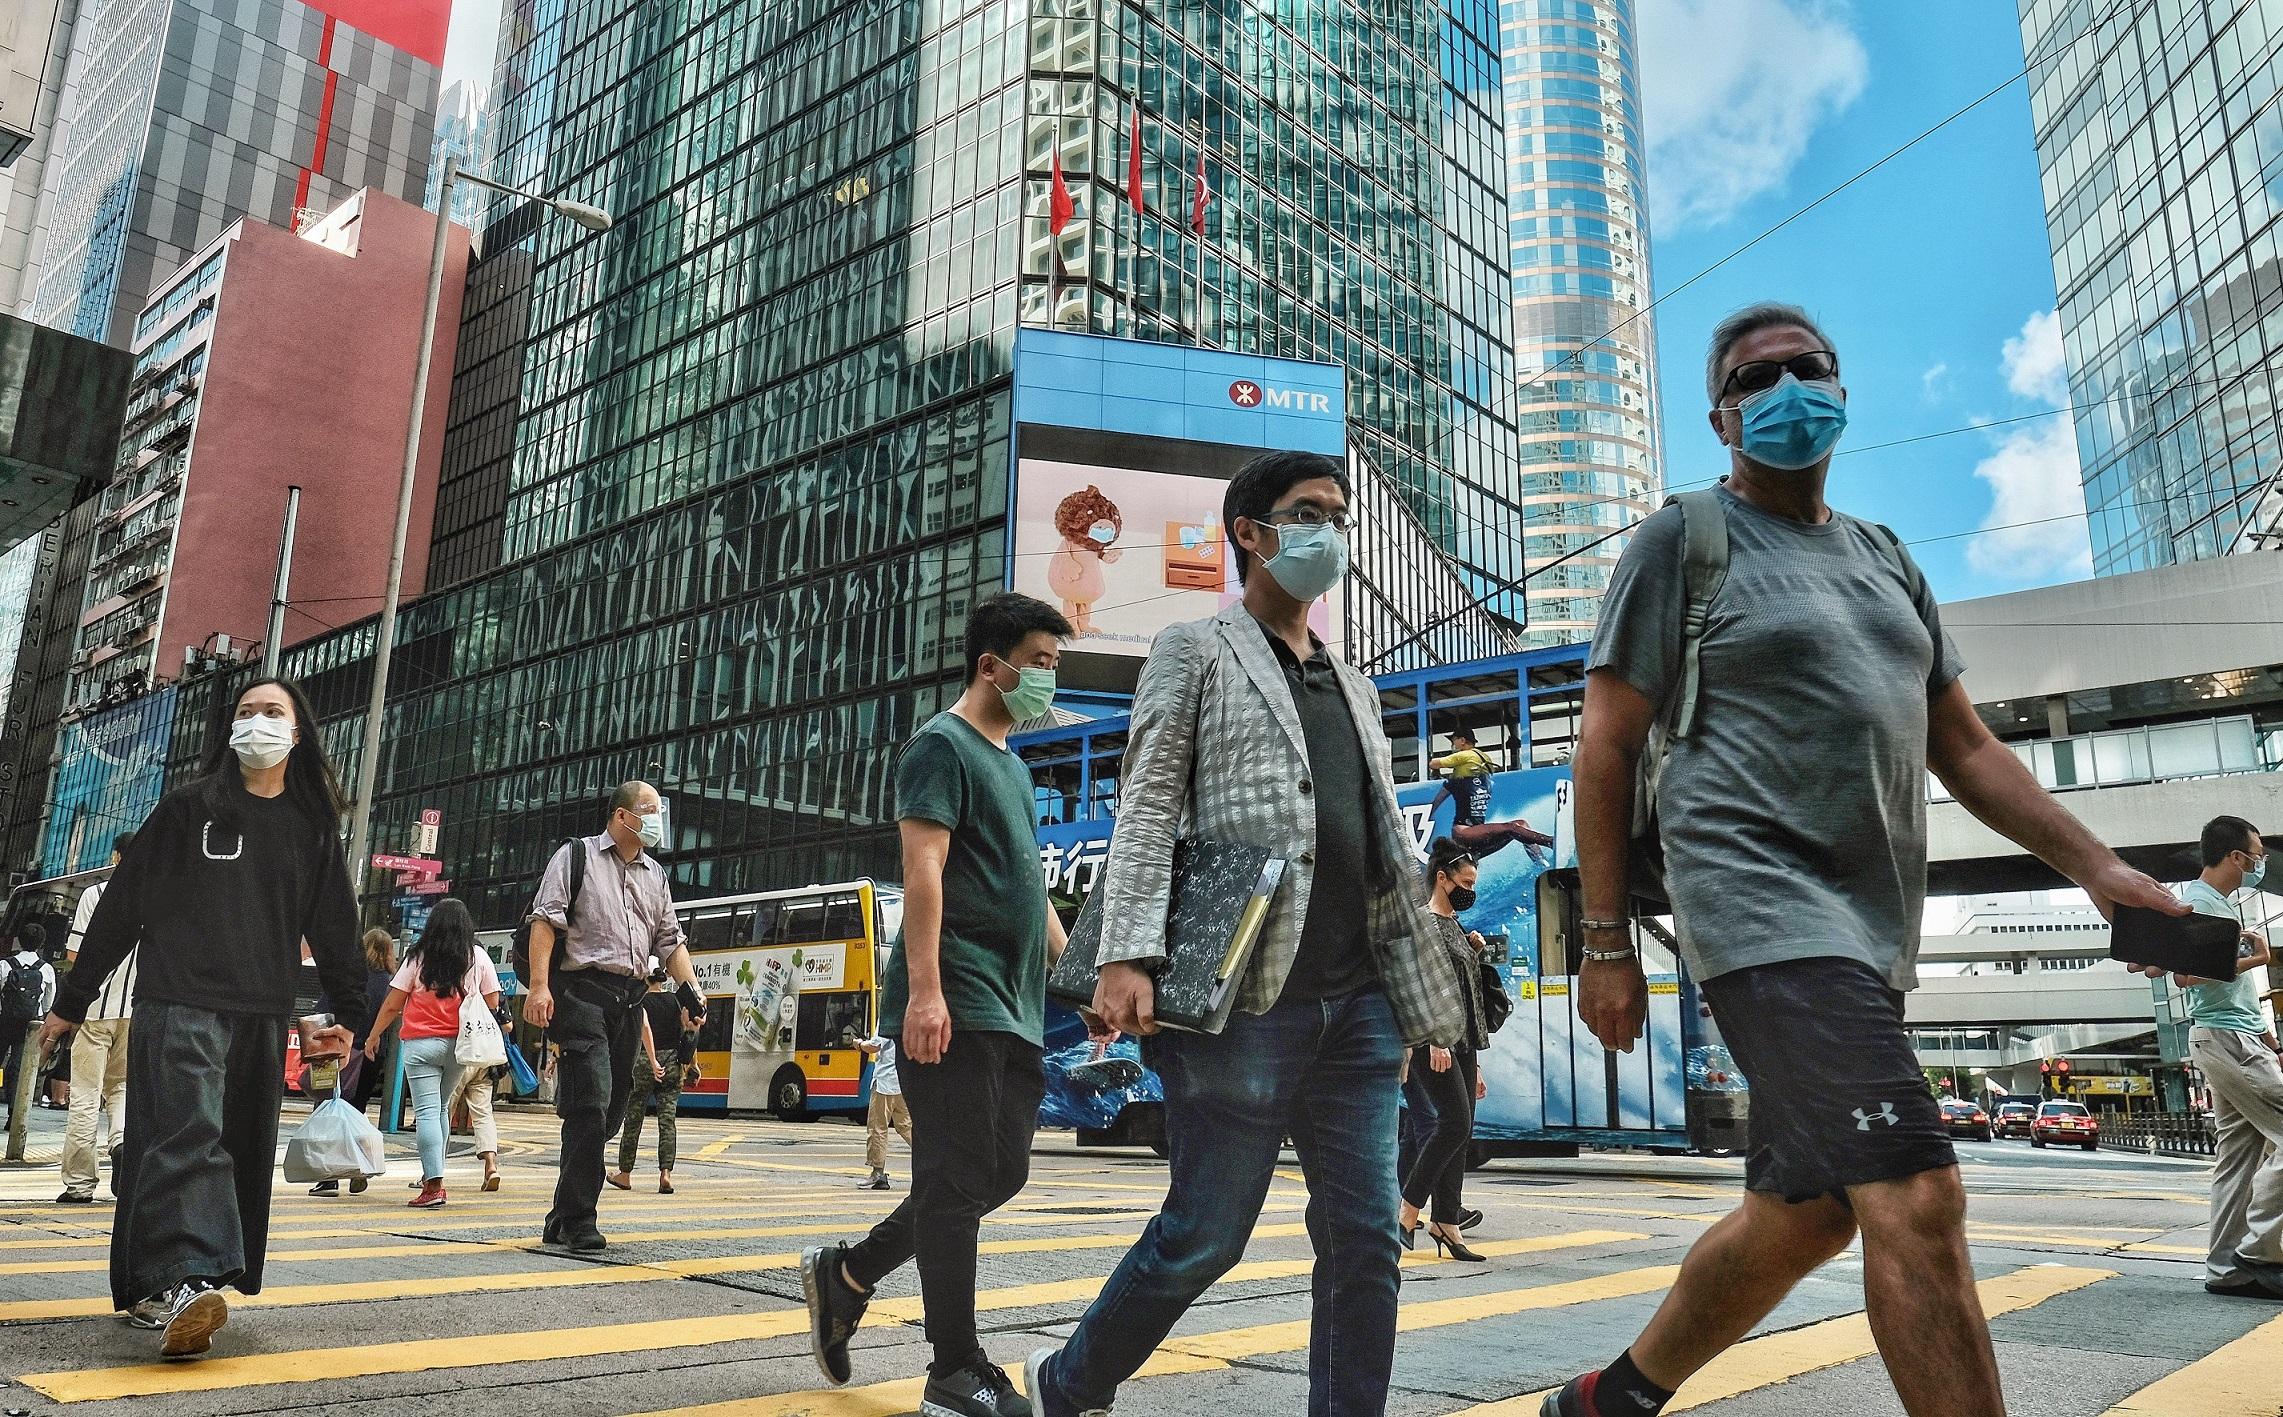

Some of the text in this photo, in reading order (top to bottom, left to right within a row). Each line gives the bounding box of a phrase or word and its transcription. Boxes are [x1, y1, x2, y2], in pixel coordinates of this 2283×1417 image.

[1266, 387, 1330, 413] MTR
[425, 828, 434, 852] Central
[815, 963, 832, 974] HMP
